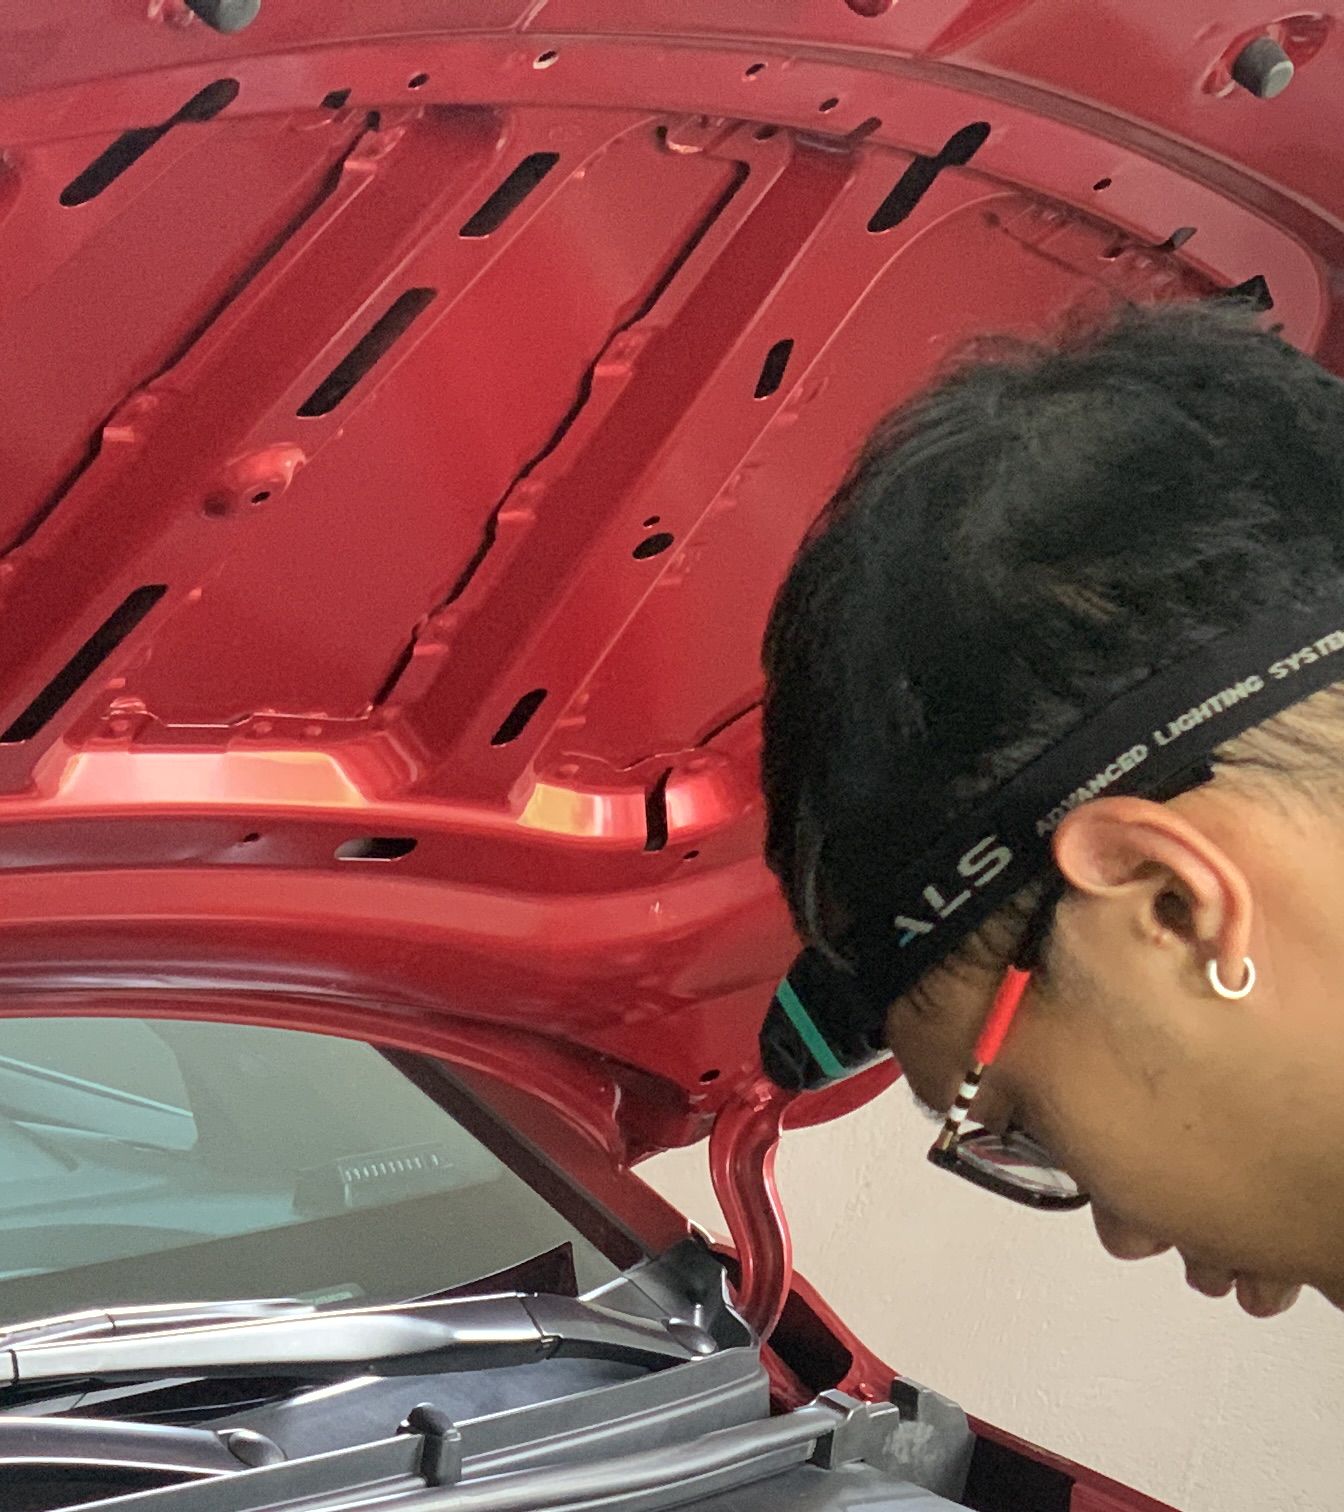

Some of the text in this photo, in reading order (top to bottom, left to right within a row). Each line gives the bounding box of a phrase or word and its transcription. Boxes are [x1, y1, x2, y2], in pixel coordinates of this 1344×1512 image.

[1036, 744, 1148, 837] ADVANCED
[1154, 675, 1265, 746] LIGHTING
[895, 835, 1013, 947] ALS
